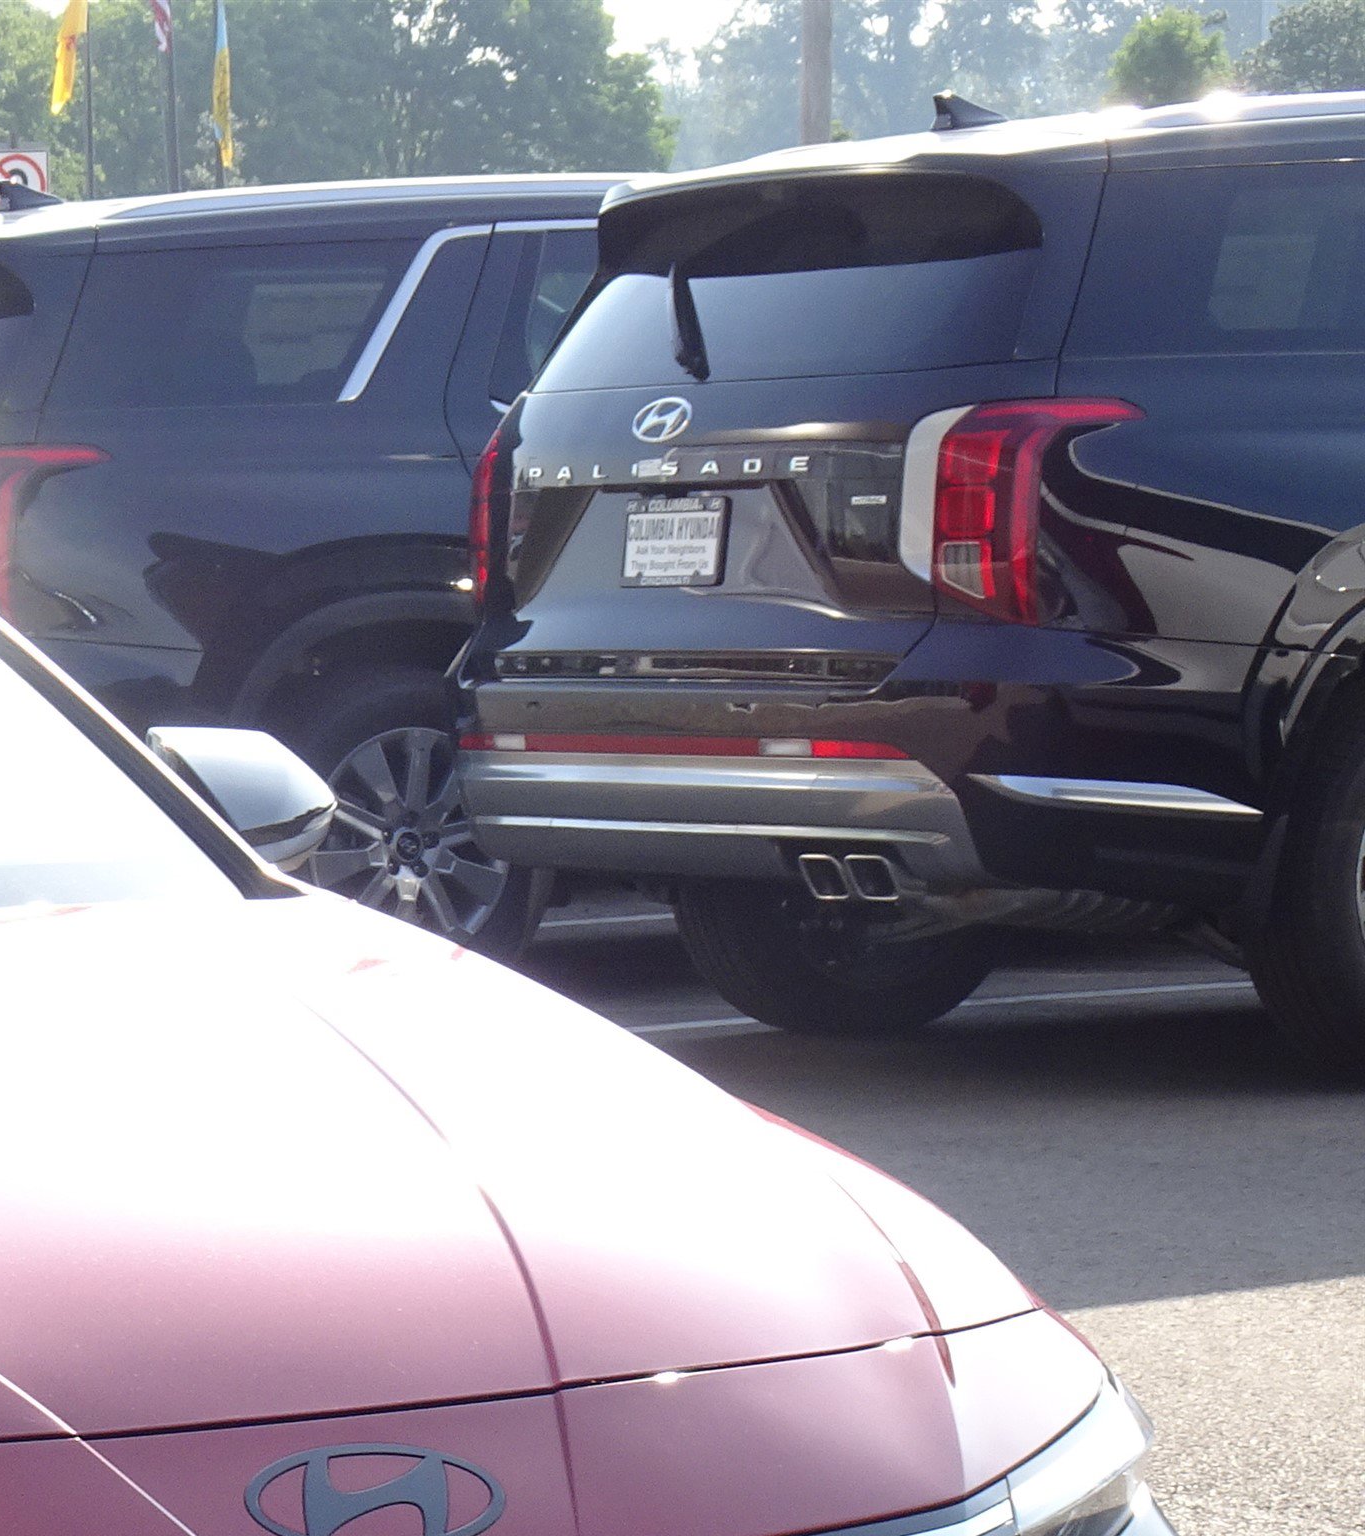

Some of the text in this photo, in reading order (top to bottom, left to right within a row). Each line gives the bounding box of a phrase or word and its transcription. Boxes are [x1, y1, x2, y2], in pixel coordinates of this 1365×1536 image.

[528, 455, 810, 480] PALISADE
[648, 498, 700, 512] COLUMBIA
[628, 518, 675, 541] COLUMBIA
